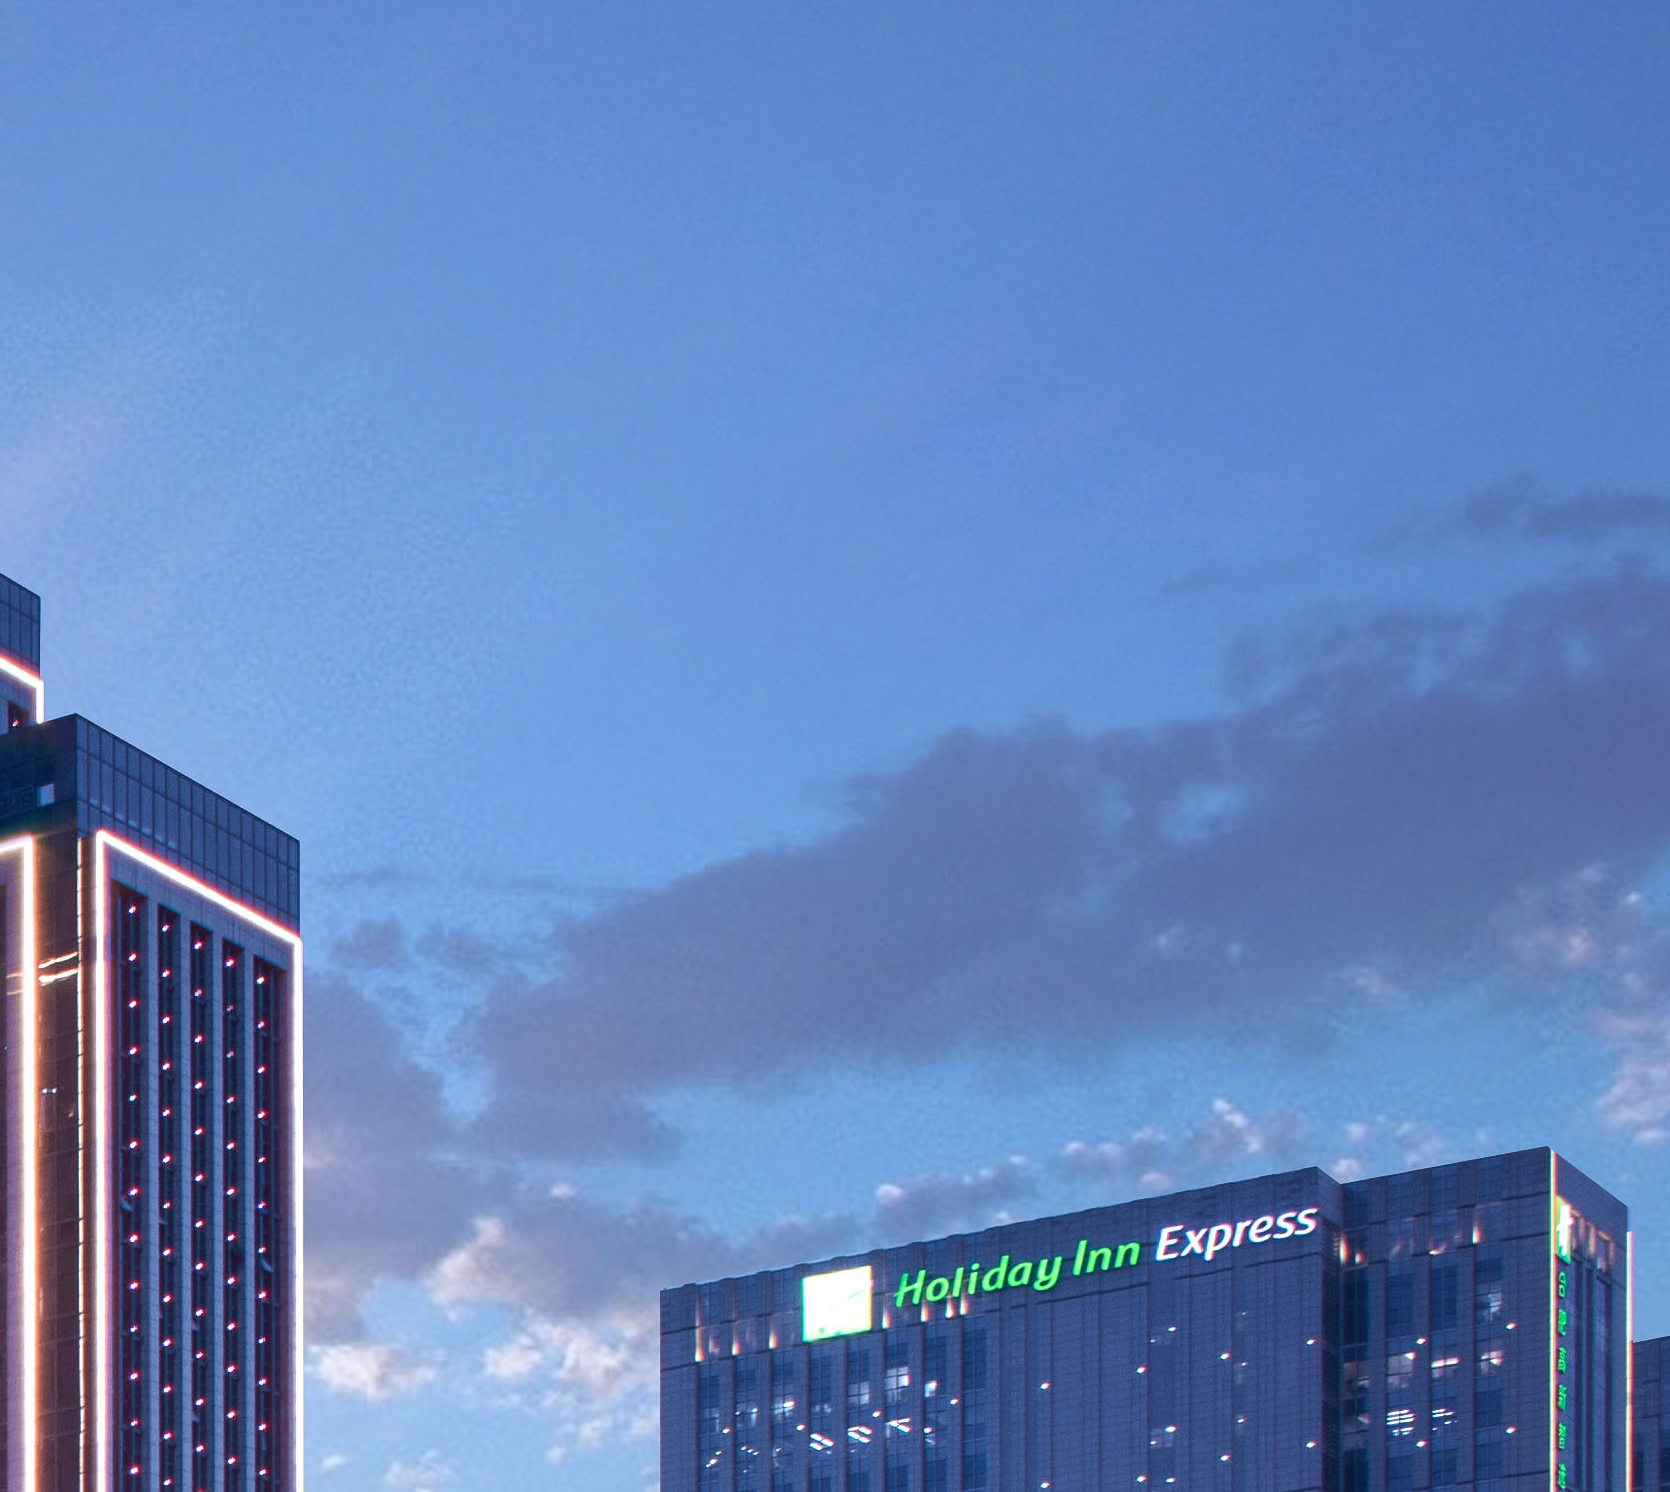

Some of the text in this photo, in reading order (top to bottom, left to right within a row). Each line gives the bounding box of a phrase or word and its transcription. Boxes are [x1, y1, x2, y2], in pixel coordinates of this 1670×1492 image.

[893, 1207, 1318, 1308] Holiday Inn Express
